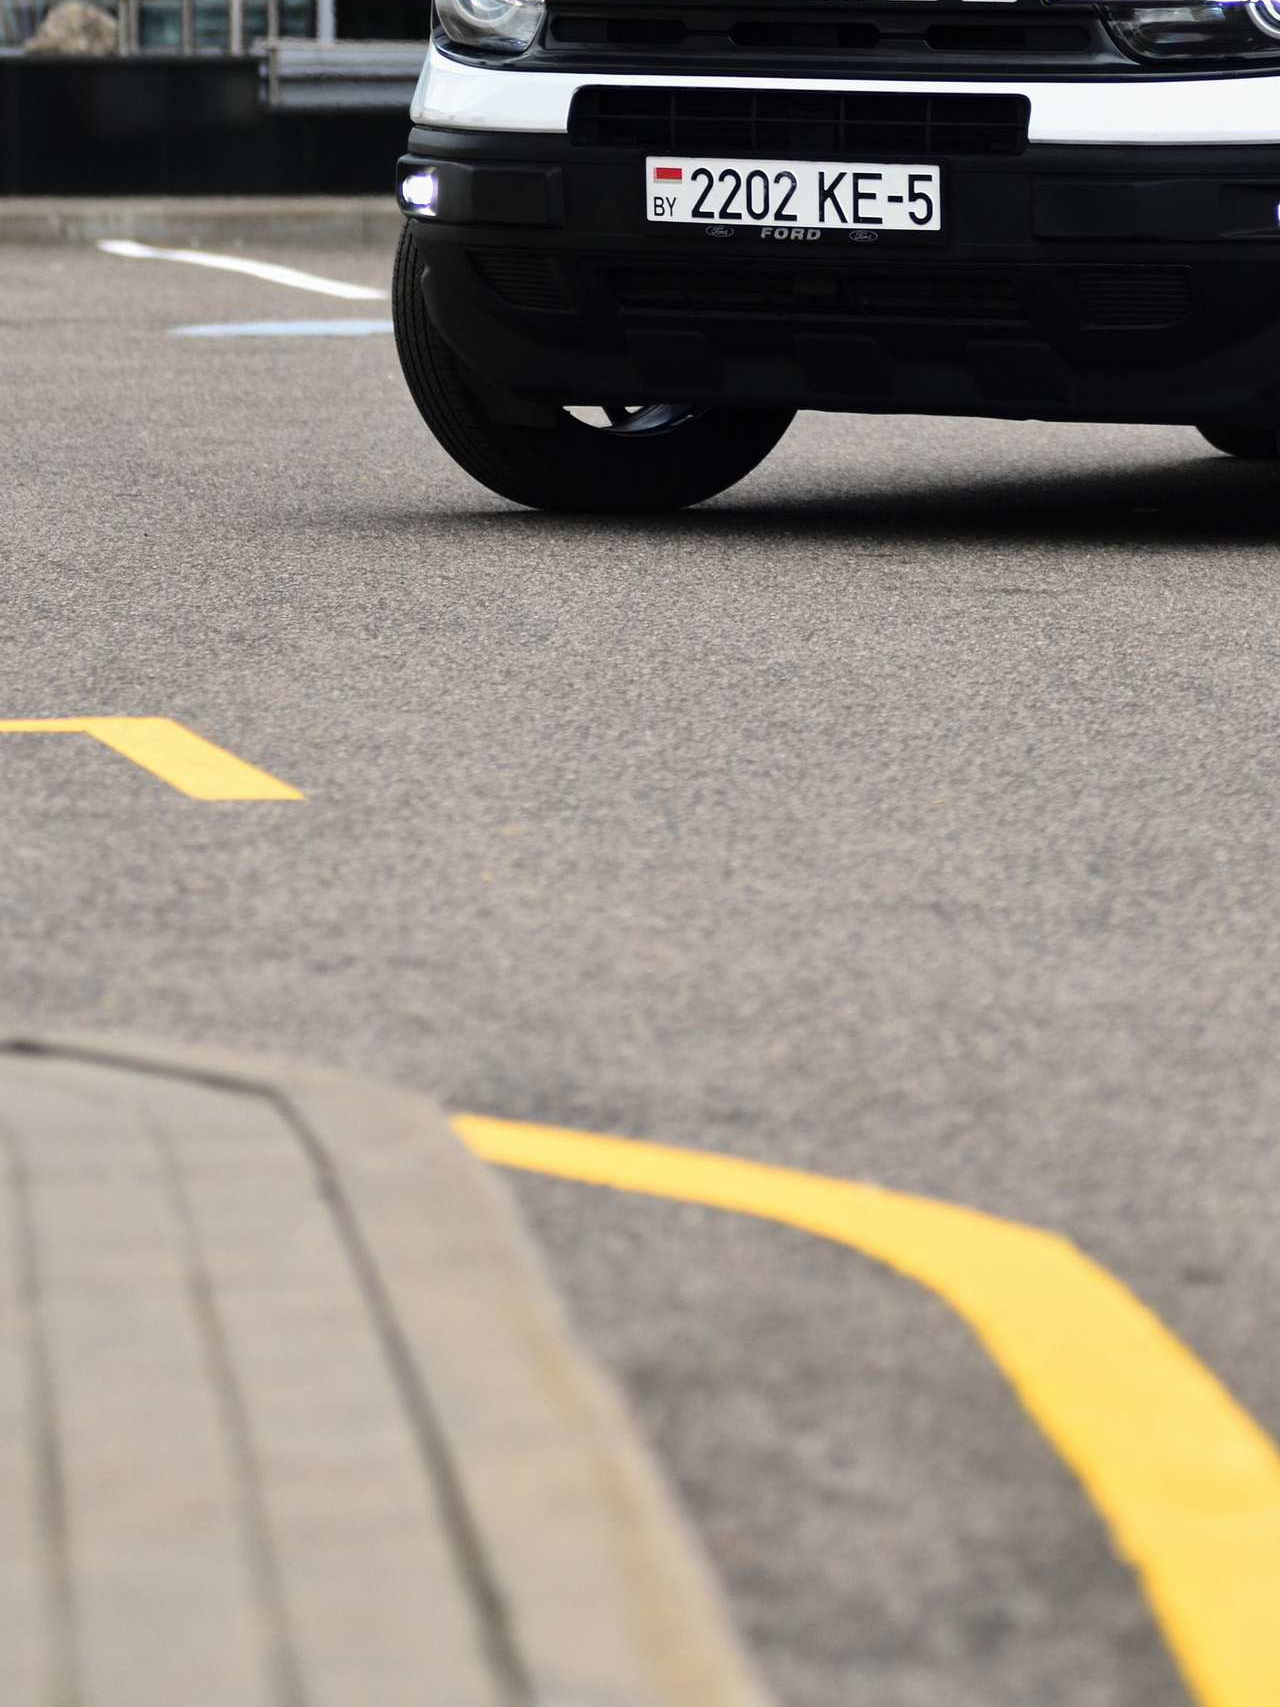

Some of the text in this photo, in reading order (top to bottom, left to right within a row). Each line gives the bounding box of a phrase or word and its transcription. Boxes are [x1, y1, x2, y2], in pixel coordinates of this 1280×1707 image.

[690, 167, 933, 225] 2202 KE-5
[653, 196, 677, 217] BY
[708, 225, 731, 236] Ford
[760, 227, 821, 241] FORD
